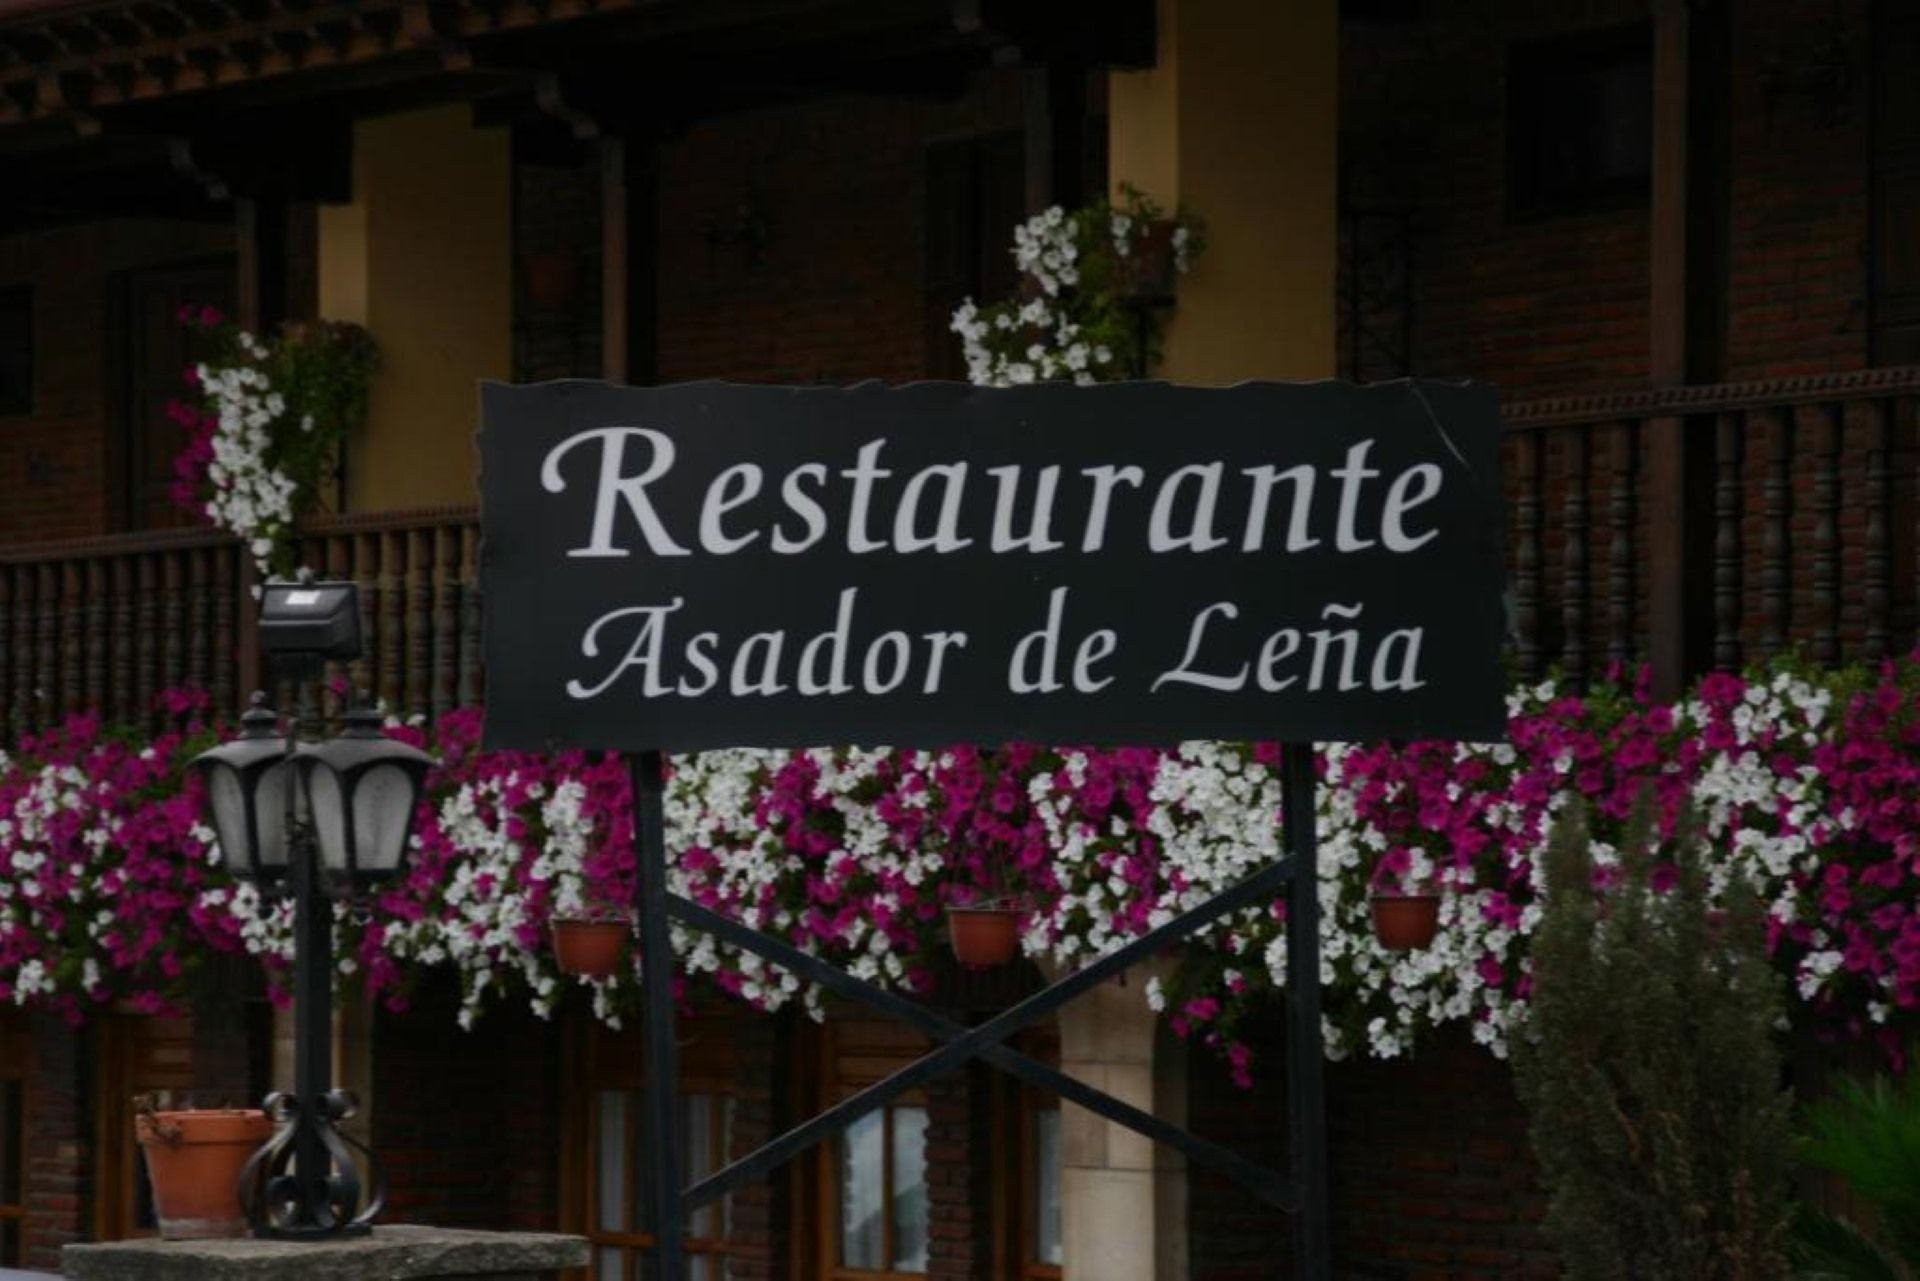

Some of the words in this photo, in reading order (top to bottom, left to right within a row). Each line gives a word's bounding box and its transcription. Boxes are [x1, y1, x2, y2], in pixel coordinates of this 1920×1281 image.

[541, 426, 1442, 558] Restaurante
[566, 586, 968, 699] Asador
[1008, 586, 1118, 694] de
[1151, 602, 1426, 693] Leña
